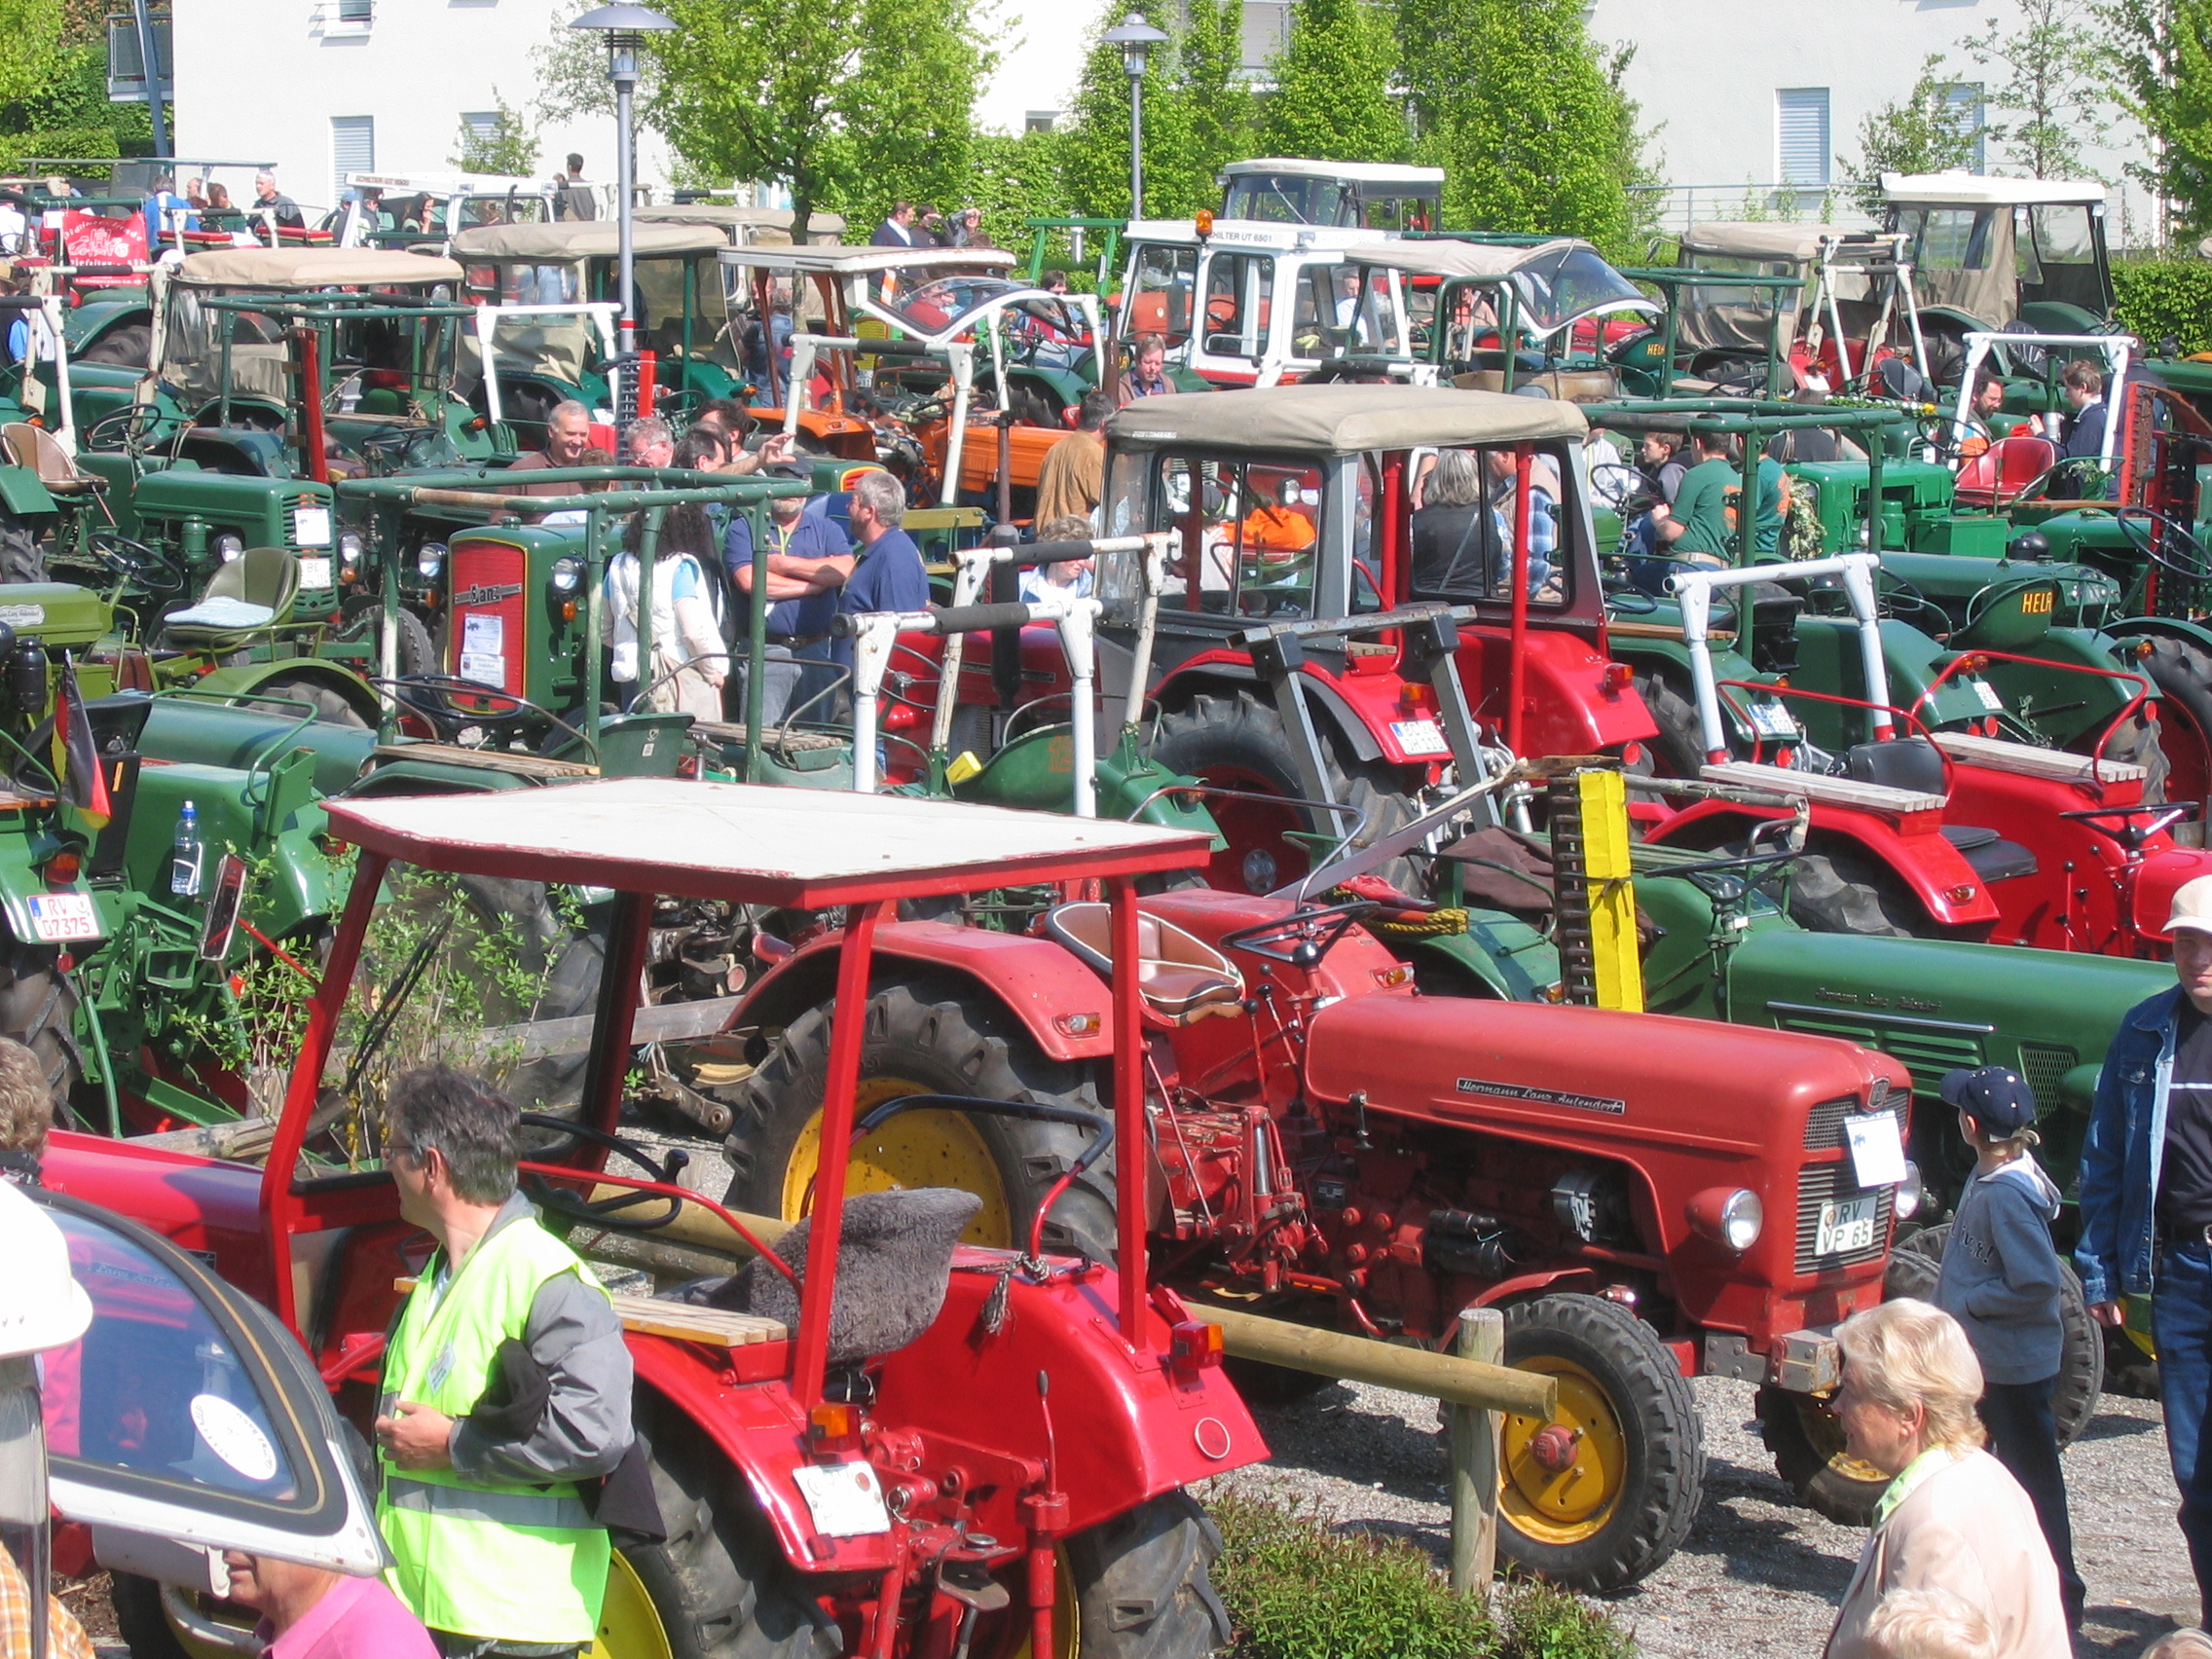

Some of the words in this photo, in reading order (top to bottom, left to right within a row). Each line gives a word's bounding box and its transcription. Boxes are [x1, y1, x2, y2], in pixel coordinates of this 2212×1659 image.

[1209, 231, 1239, 240] HILTER
[1241, 233, 1253, 241] UT
[1254, 234, 1272, 242] 6501
[2022, 591, 2052, 613] HELA
[47, 898, 67, 916] RV
[41, 916, 91, 937] 07375
[1459, 1080, 1520, 1096] Hermann
[1522, 1088, 1553, 1102] Lanz
[1838, 1200, 1862, 1225] RV
[1822, 1229, 1846, 1255] VP
[1851, 1222, 1869, 1247] 65
